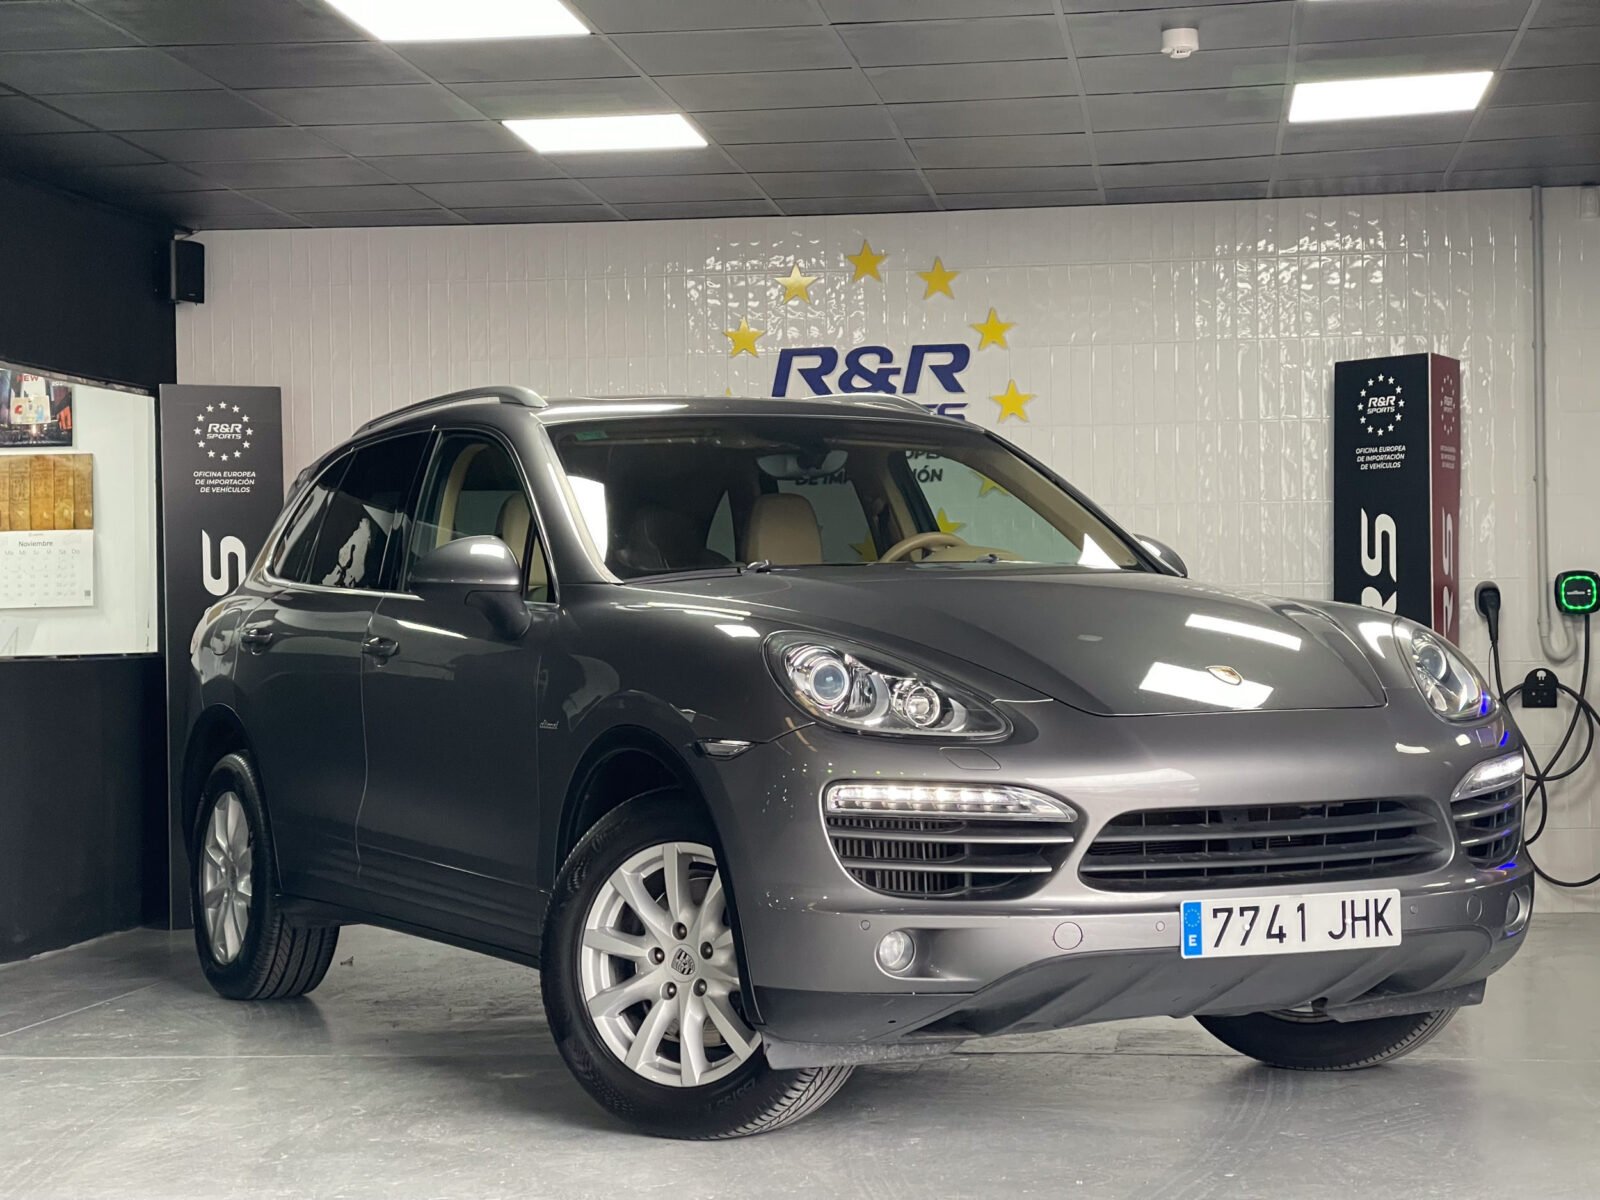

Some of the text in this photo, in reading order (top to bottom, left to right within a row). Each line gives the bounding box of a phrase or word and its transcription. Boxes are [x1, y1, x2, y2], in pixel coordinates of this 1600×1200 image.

[771, 343, 970, 397] R&R
[1368, 396, 1396, 408] R&R
[1367, 406, 1396, 414] SPORTS
[207, 423, 243, 433] R&R
[1379, 445, 1406, 453] EUROPEA
[1365, 453, 1405, 462] IMPORTACIÓN
[1212, 897, 1394, 949] 7741 JHK
[1187, 934, 1198, 947] E
